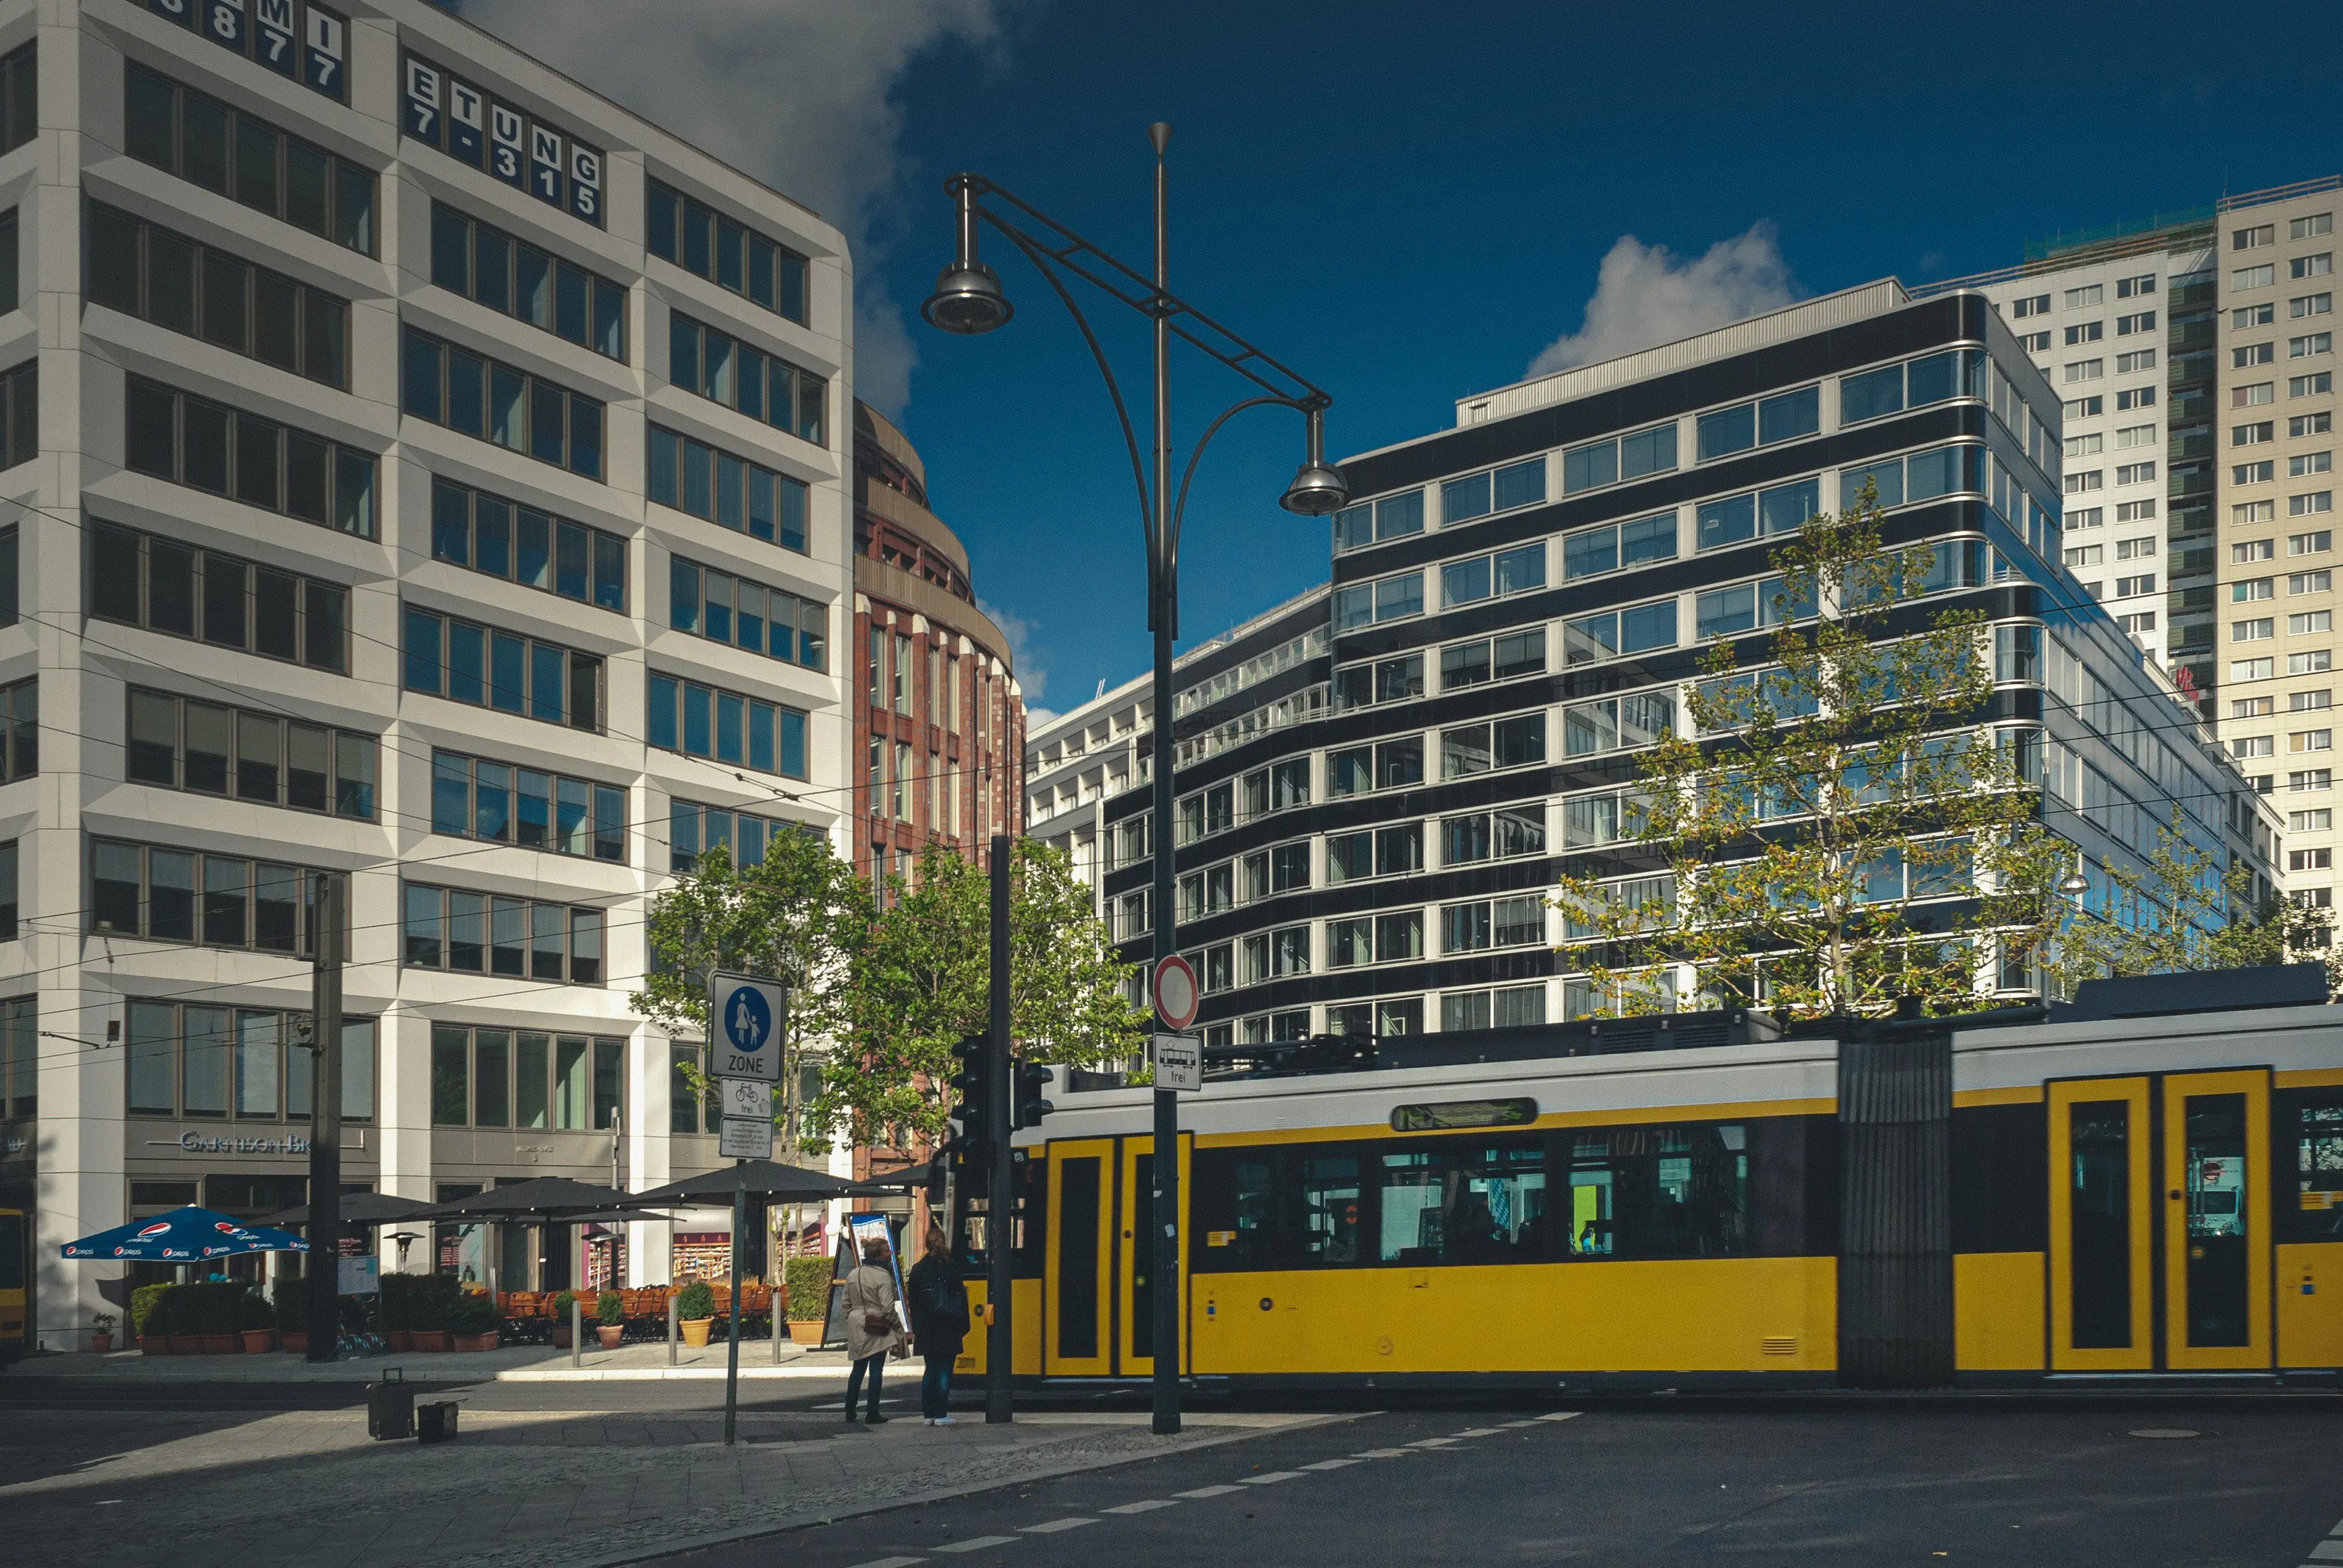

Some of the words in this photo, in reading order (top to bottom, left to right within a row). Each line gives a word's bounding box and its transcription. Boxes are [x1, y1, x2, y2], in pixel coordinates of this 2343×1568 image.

[415, 68, 595, 181] ETUNG
[414, 105, 594, 214] 7-315
[728, 1054, 764, 1073] ZONE
[1171, 1070, 1185, 1083] frei
[741, 1103, 753, 1114] frei
[123, 1249, 142, 1257] pepsi
[171, 1250, 189, 1258] pepsi
